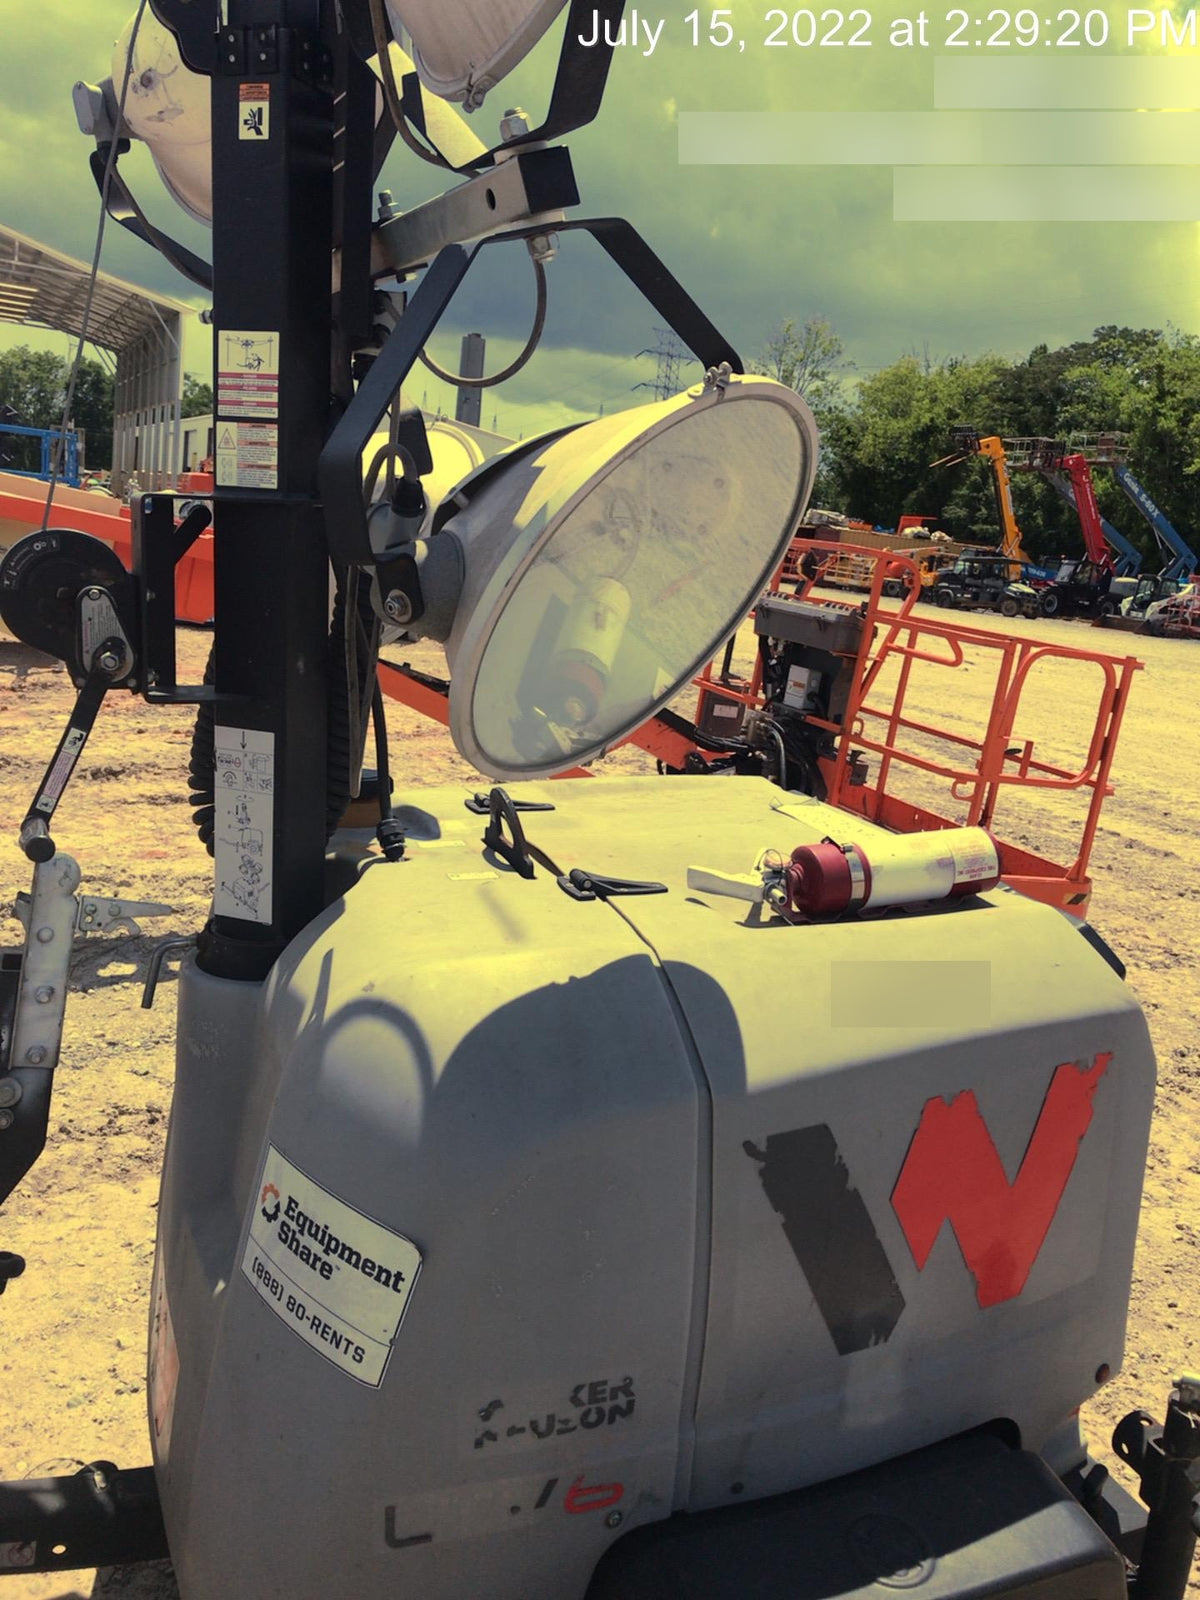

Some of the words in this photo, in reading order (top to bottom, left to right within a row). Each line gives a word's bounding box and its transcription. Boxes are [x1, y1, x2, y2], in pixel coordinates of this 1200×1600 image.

[277, 1220, 334, 1280] Share
[283, 1195, 405, 1293] Equipment
[251, 1257, 284, 1302] (888)
[286, 1295, 366, 1364] 80-RENTS
